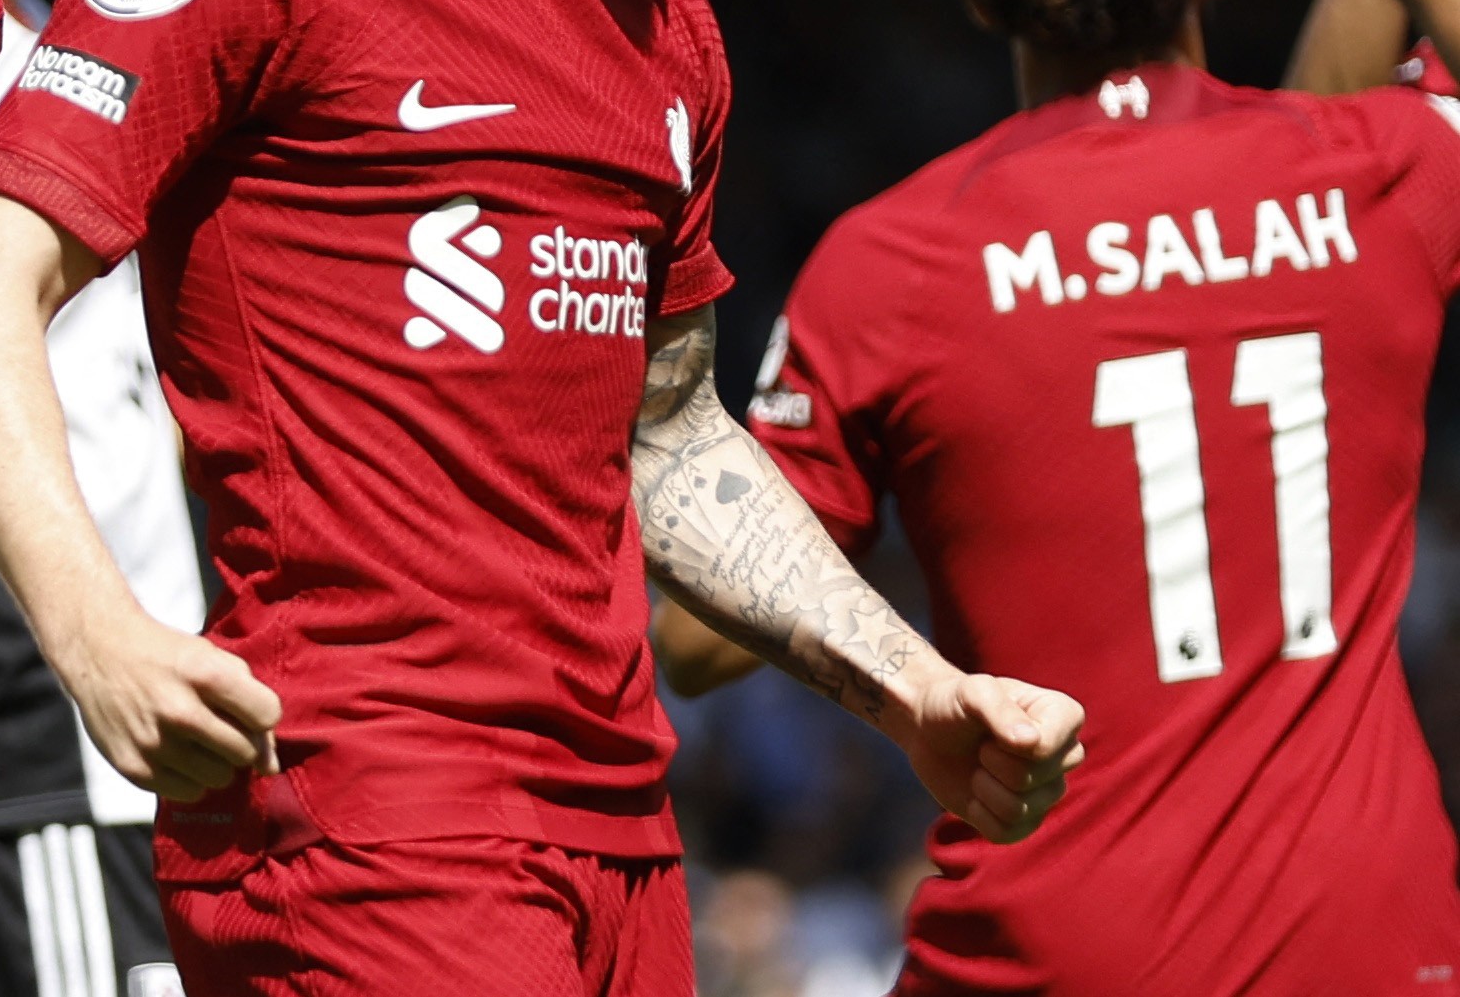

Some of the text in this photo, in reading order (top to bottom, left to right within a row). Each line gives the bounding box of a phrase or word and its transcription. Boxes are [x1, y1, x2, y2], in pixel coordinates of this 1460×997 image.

[30, 45, 127, 98] No room
[41, 70, 128, 125] racism
[981, 186, 1359, 314] M.SALAH
[1091, 330, 1339, 684] 11
